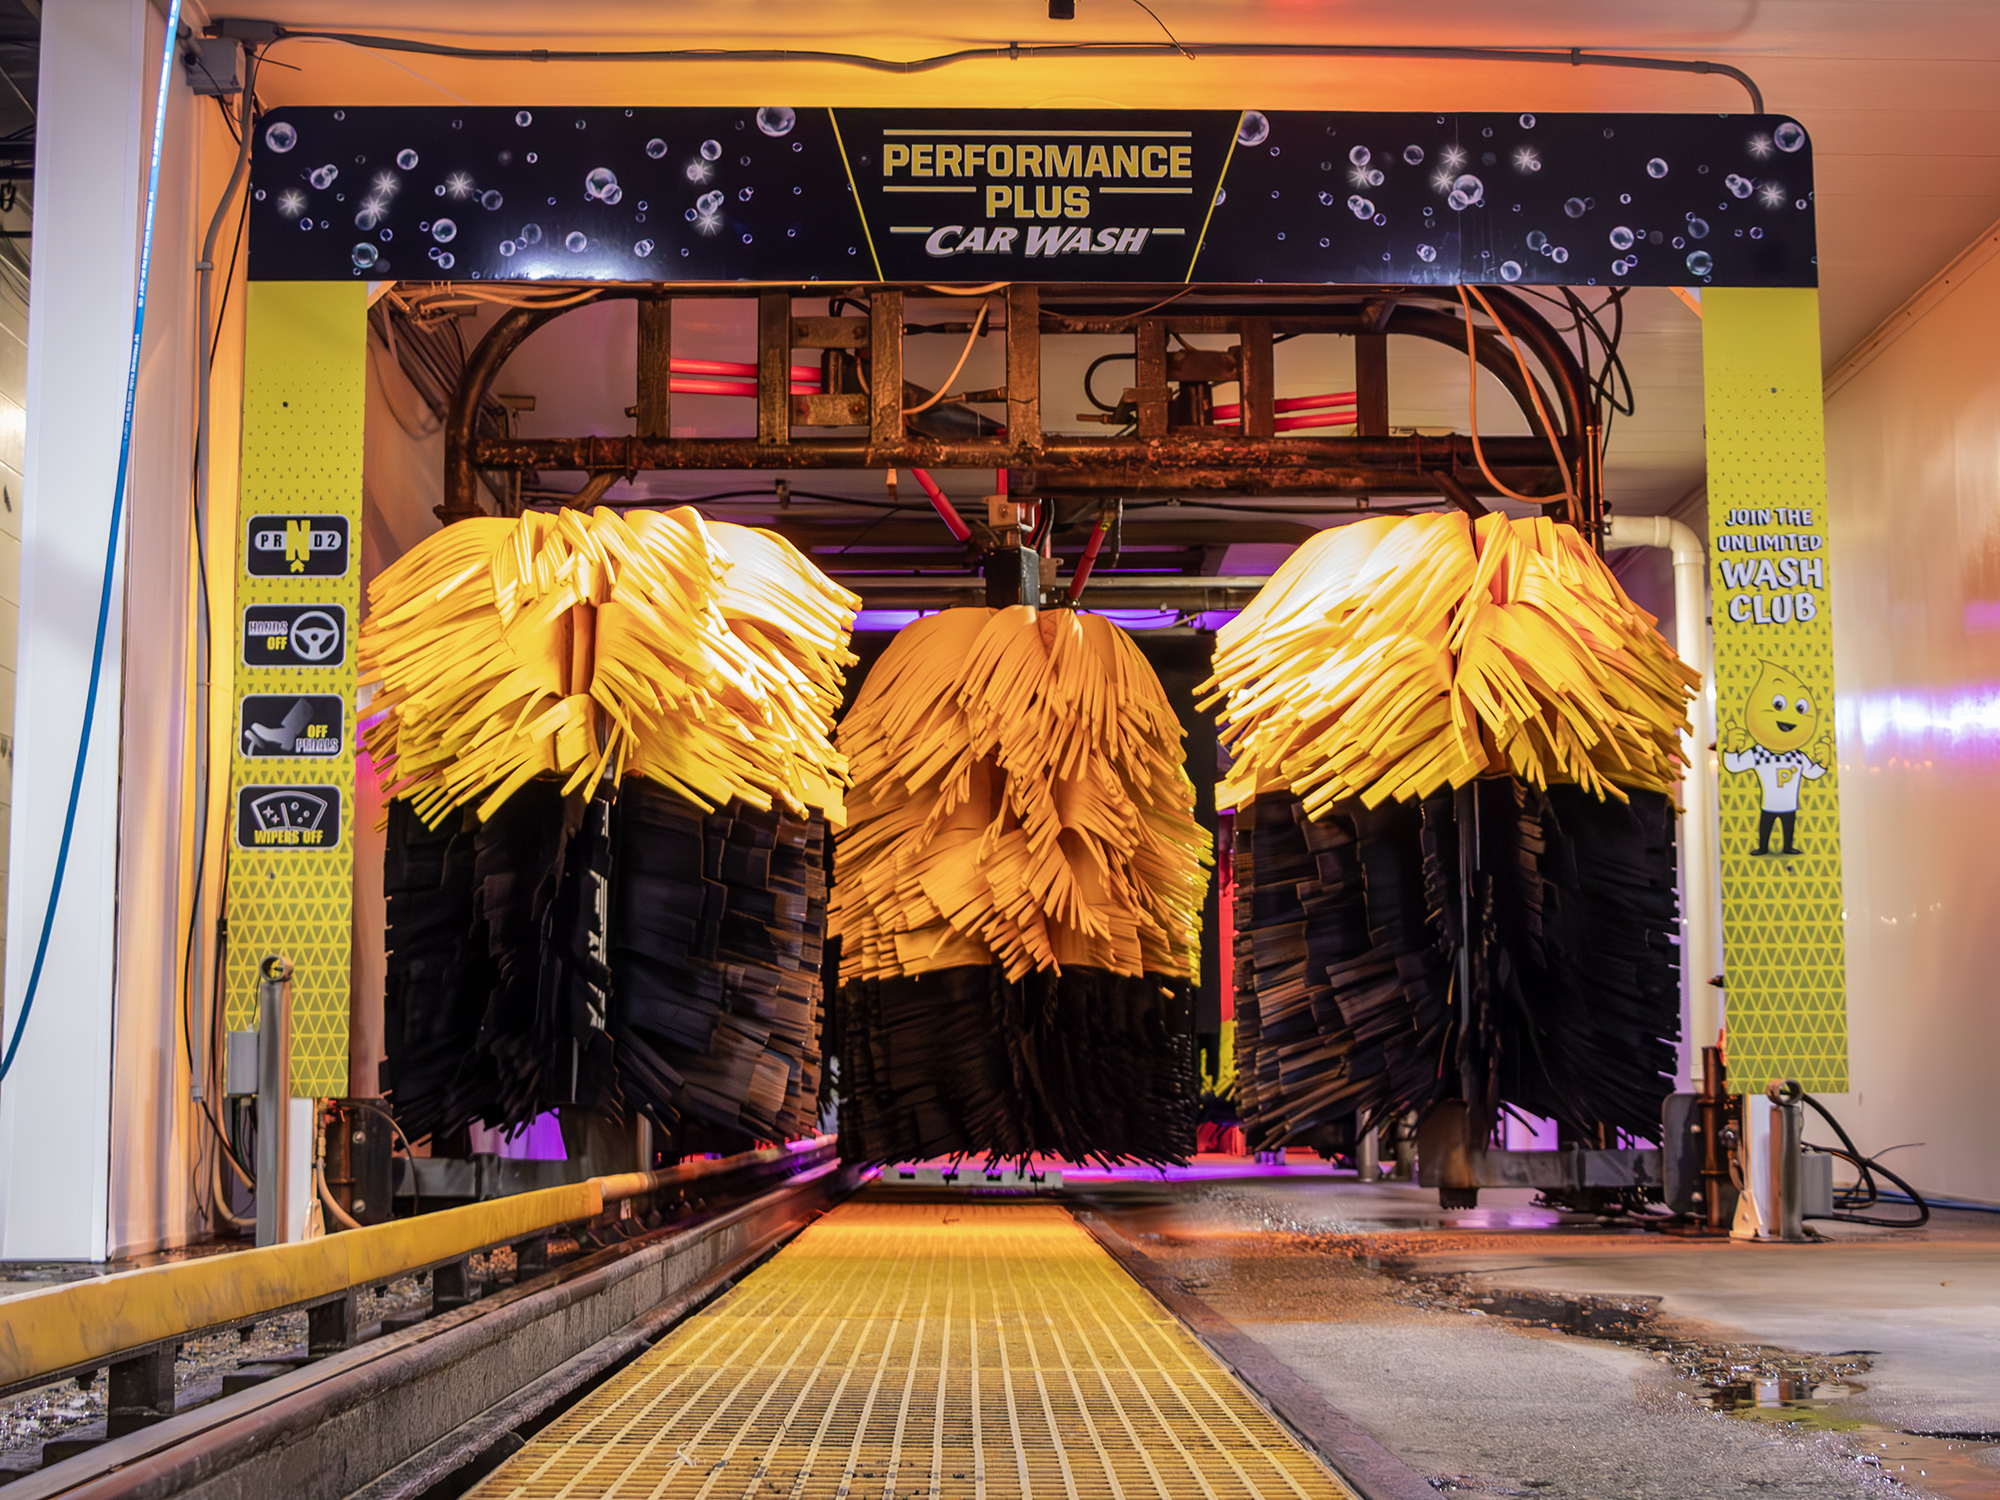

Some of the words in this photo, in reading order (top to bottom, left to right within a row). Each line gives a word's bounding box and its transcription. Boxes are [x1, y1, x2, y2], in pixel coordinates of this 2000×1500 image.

[883, 144, 1192, 178] PERFORMANCE
[986, 185, 1090, 218] PLUS
[925, 225, 1020, 257] CAR
[1024, 226, 1150, 257] WASH
[1725, 508, 1771, 526] JOIN
[1773, 507, 1814, 526] THE
[1717, 533, 1823, 552] UNLIMITED
[1719, 556, 1824, 590] WASH
[1728, 592, 1818, 625] CLUB
[248, 621, 288, 636] HANDS
[267, 636, 288, 650] OFF
[307, 724, 328, 738] OFF
[295, 738, 339, 753] PEDALS
[254, 829, 300, 845] WIPERS
[303, 829, 323, 844] OFF
